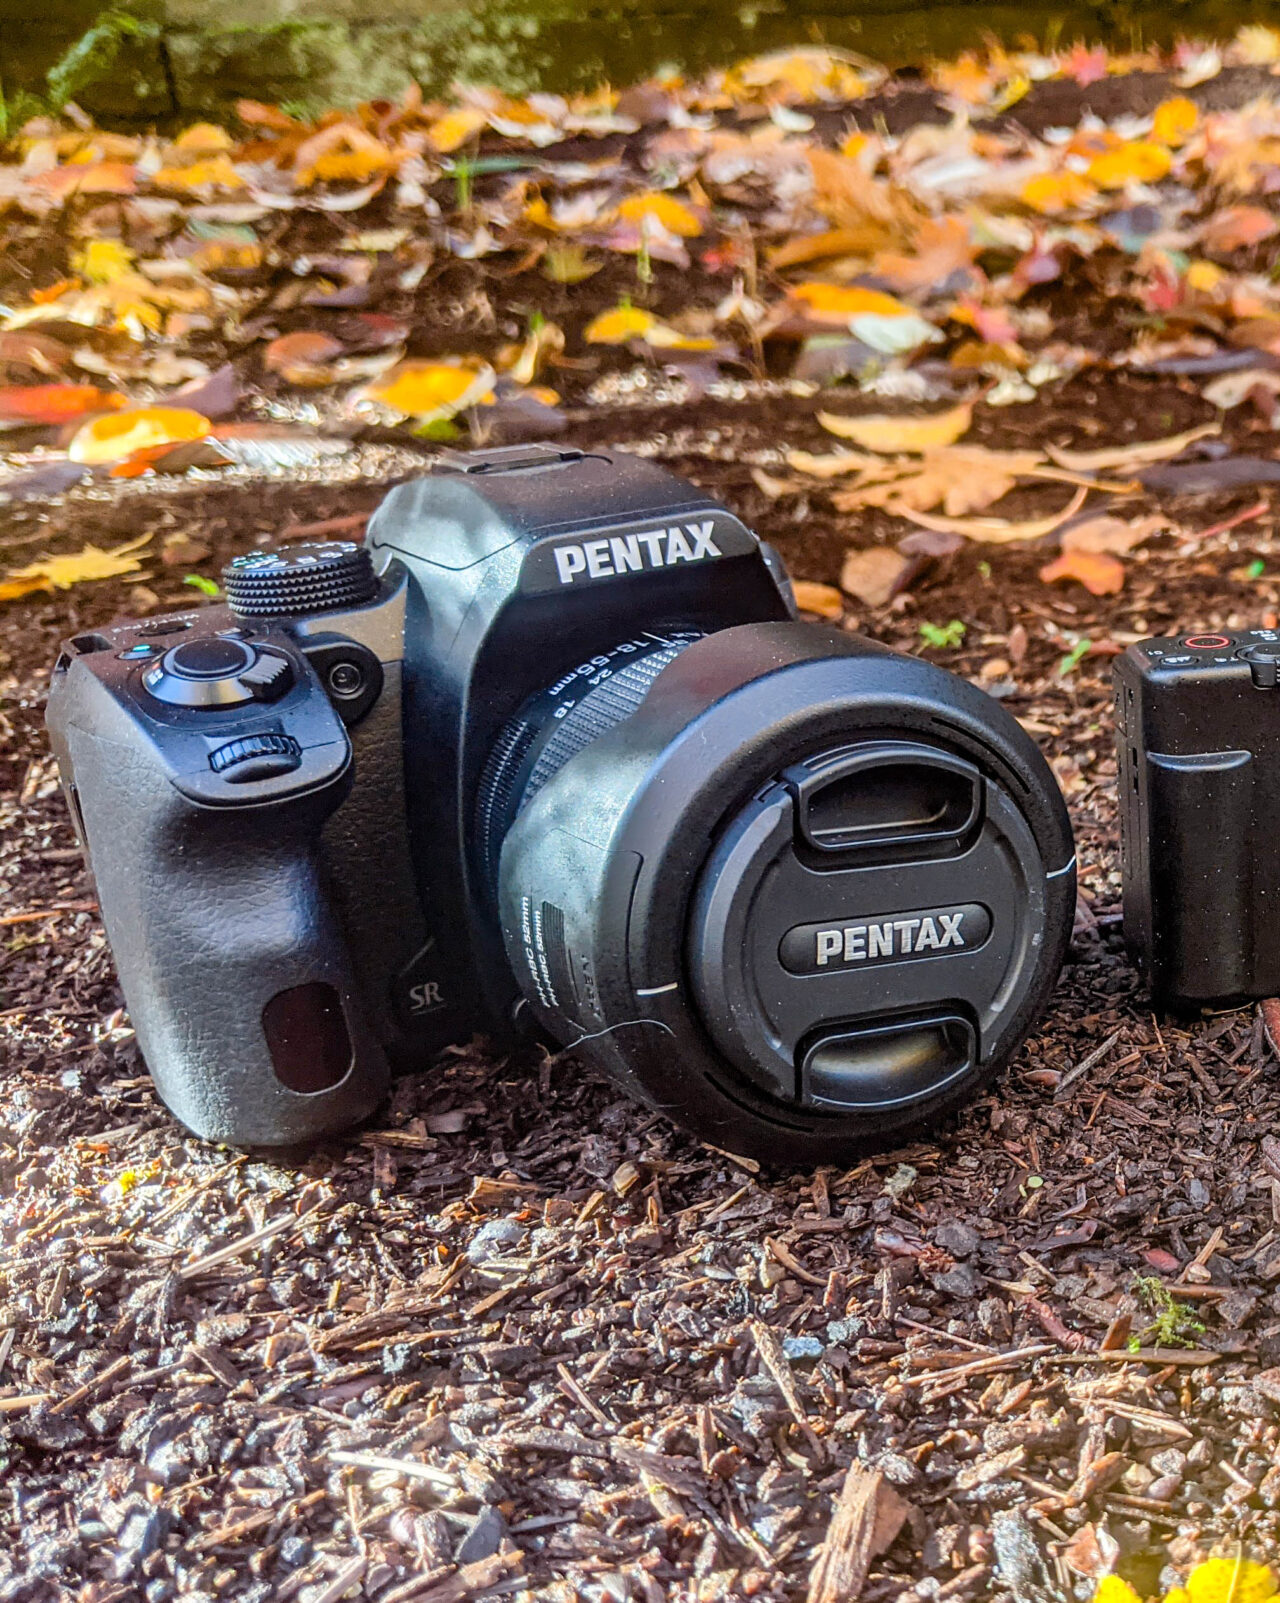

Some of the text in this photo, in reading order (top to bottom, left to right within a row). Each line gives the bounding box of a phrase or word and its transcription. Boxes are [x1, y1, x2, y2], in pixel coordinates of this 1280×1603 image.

[553, 520, 722, 583] PENTAX
[548, 639, 651, 696] 18-55mm
[587, 668, 613, 686] 24
[553, 698, 576, 719] 18
[521, 896, 532, 945] 52mm
[816, 913, 965, 966] PENTAX
[410, 981, 445, 1010] SR
